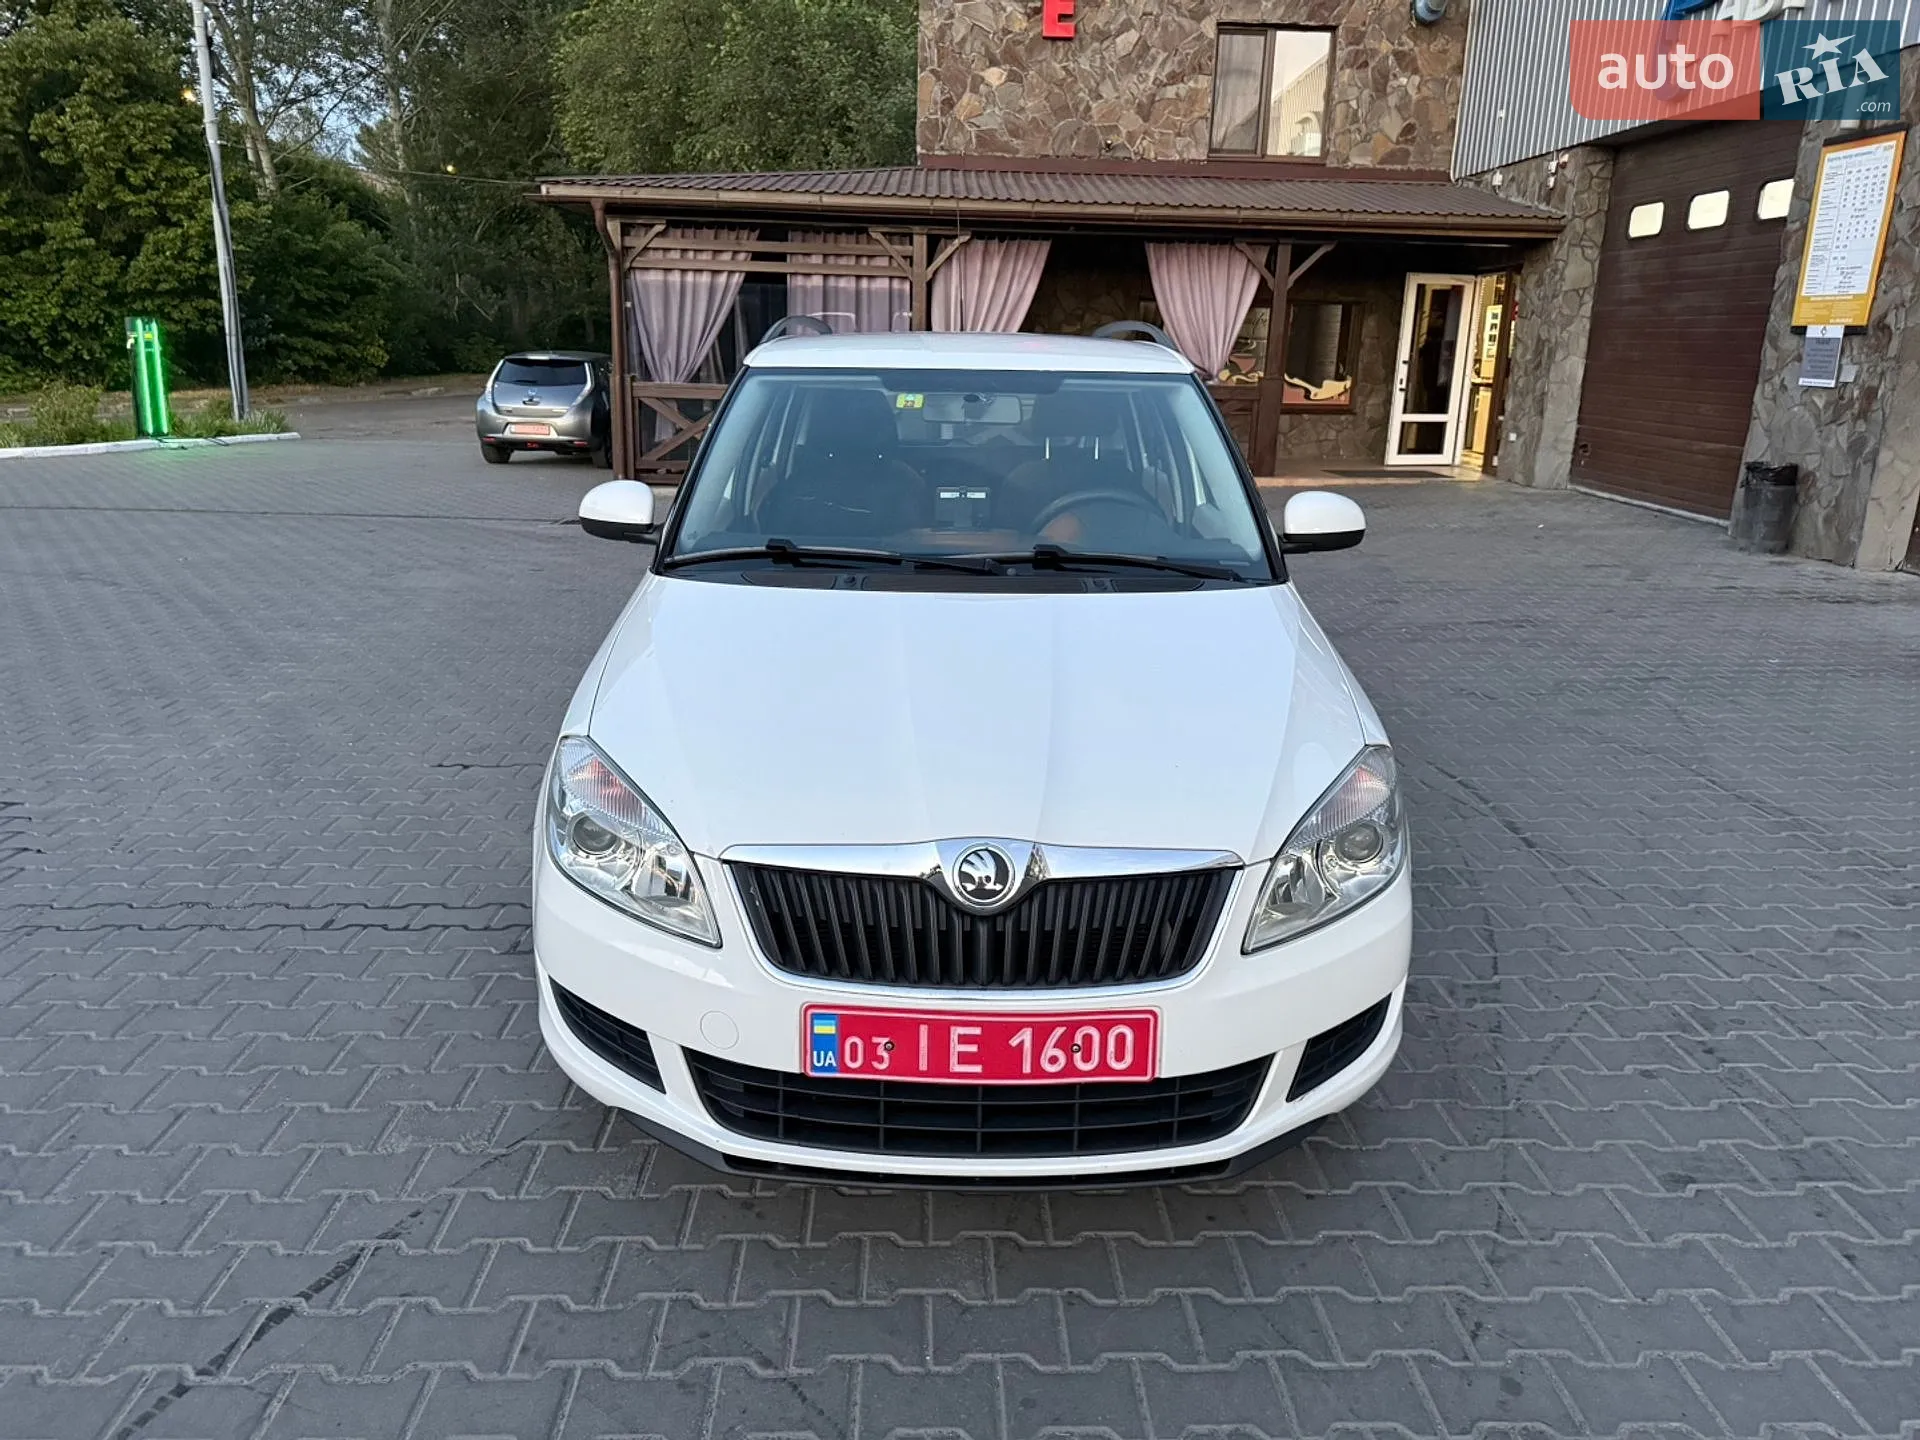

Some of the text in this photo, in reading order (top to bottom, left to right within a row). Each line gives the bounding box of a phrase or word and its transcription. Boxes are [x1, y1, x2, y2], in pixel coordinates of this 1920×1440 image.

[812, 1050, 837, 1067] UA
[844, 1023, 1135, 1074] 03 IE 1600
